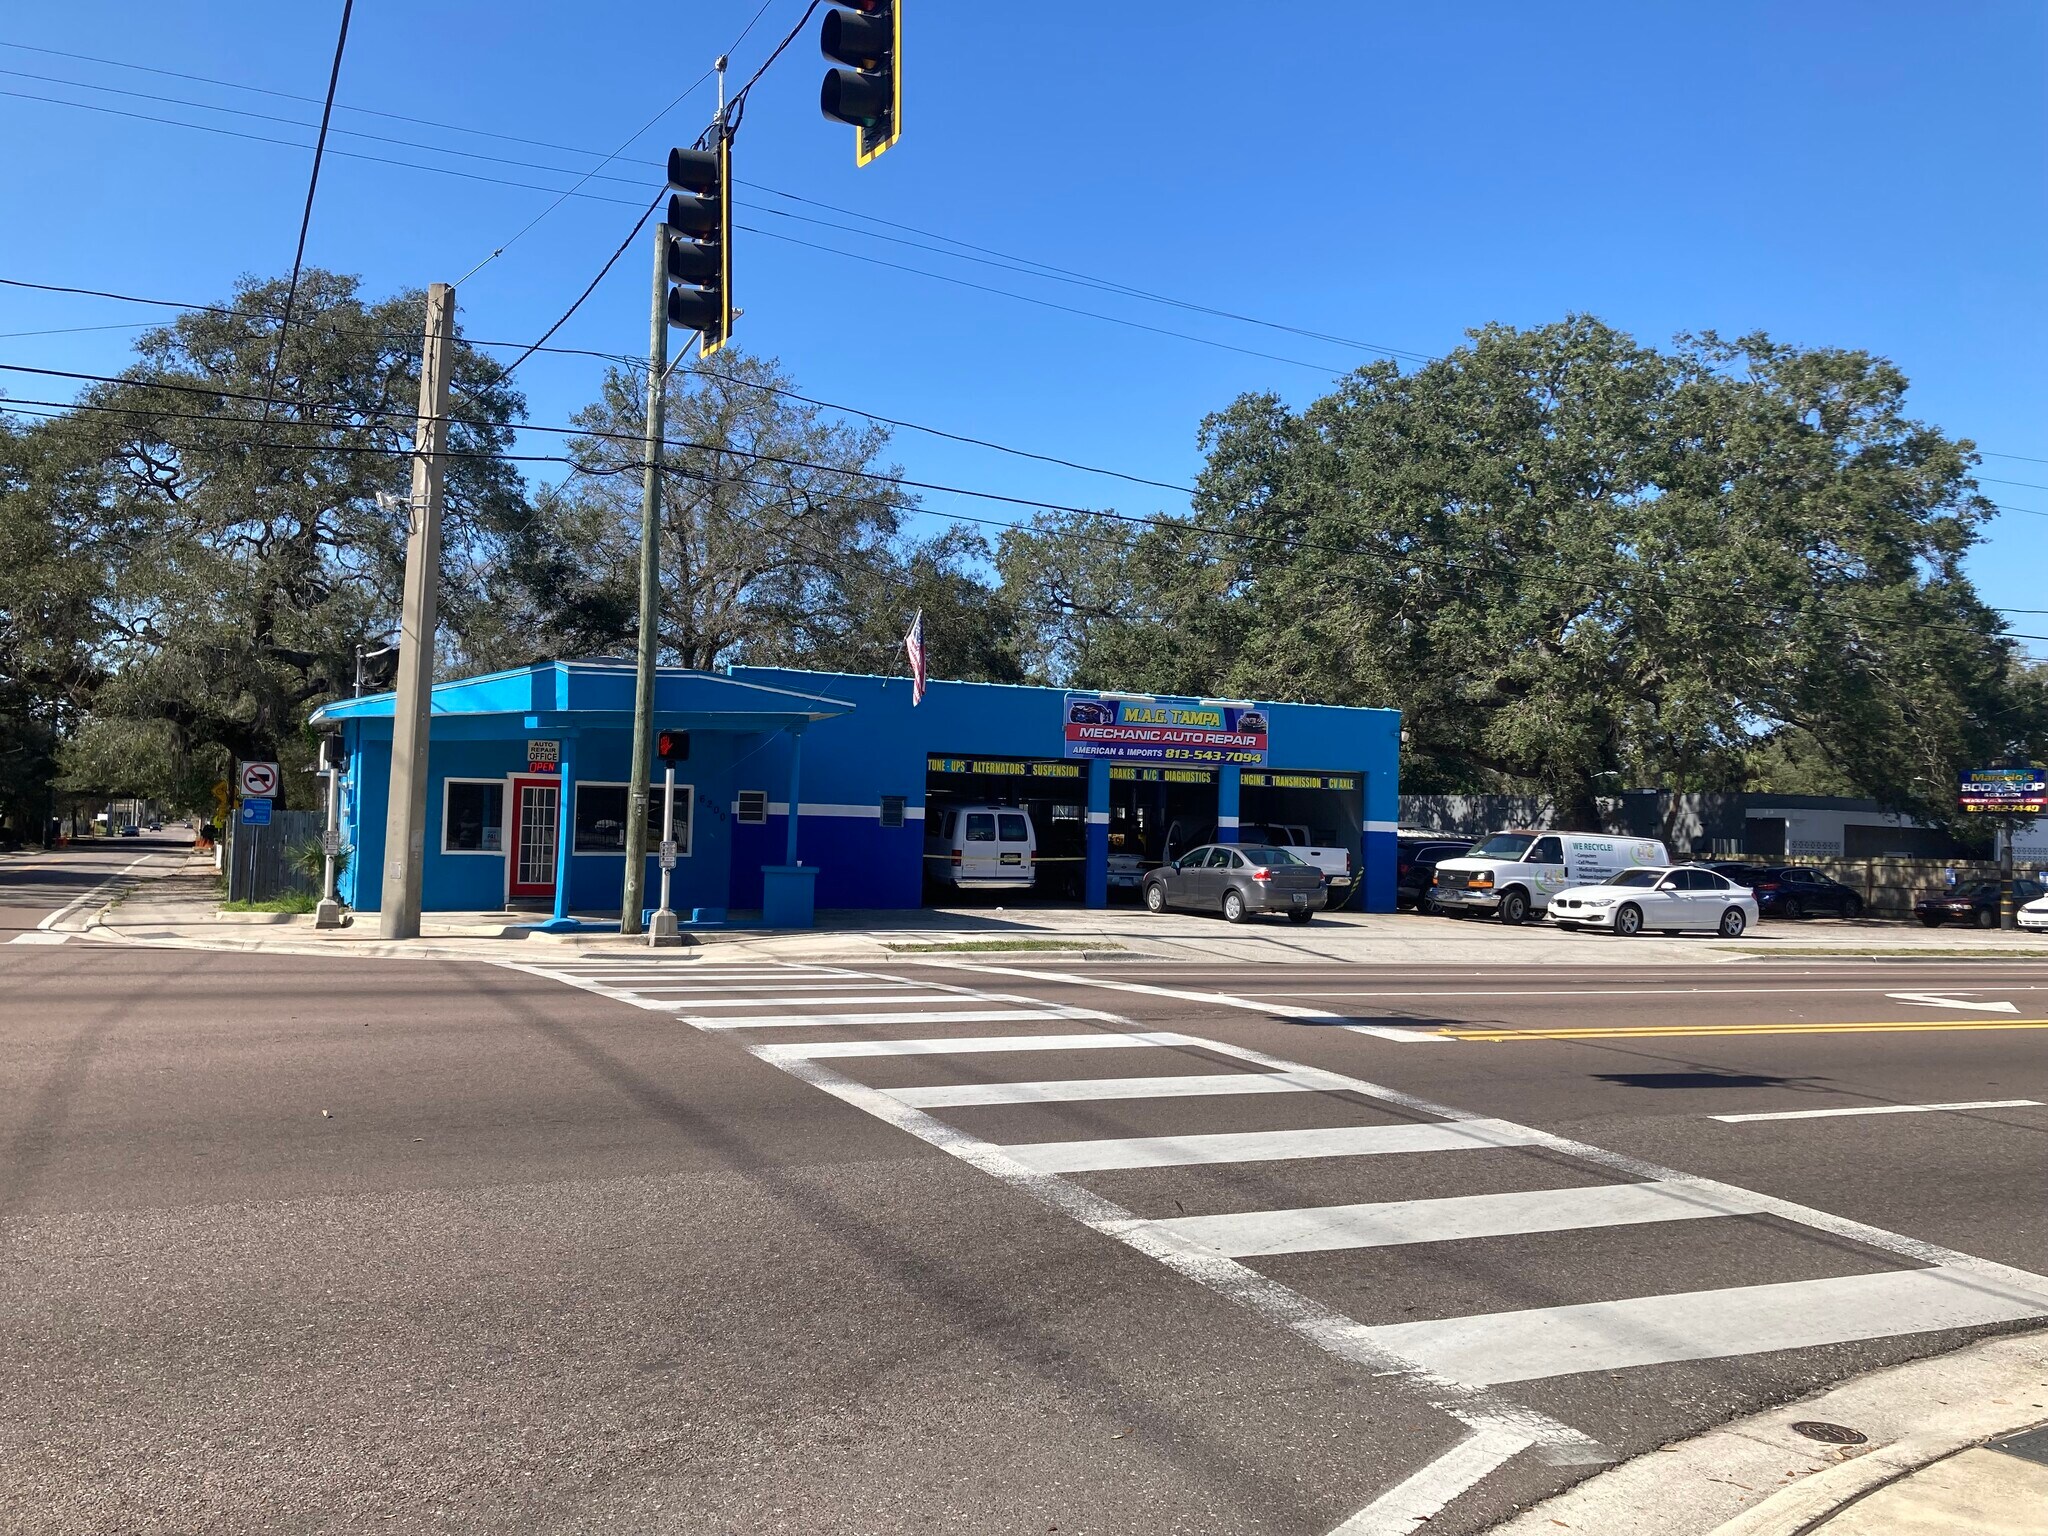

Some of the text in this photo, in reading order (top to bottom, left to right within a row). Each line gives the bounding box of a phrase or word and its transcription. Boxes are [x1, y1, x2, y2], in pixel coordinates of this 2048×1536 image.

[1124, 707, 1221, 727] M.A.G. TAMPA
[1079, 727, 1257, 746] MECHANIC AUTO REPAIR
[529, 752, 557, 761] OFFICE
[1072, 746, 1262, 763] AMERICAN & IMPORTS 813-543-7094
[529, 762, 555, 773] OPEN
[928, 759, 945, 771] TUNE
[951, 761, 966, 773] UPS
[972, 762, 1026, 776] ALTERNATORS
[1032, 764, 1079, 778] SUSPENSION
[1109, 768, 1211, 783] BRAKES A/C DIAGNOSTICS
[1240, 774, 1265, 785] ENGINE
[1271, 775, 1321, 788] TRANSMISSION
[1338, 779, 1354, 790] AXLE
[1971, 773, 2035, 782] Marcelo's
[1961, 782, 2046, 792] BODY SHOP
